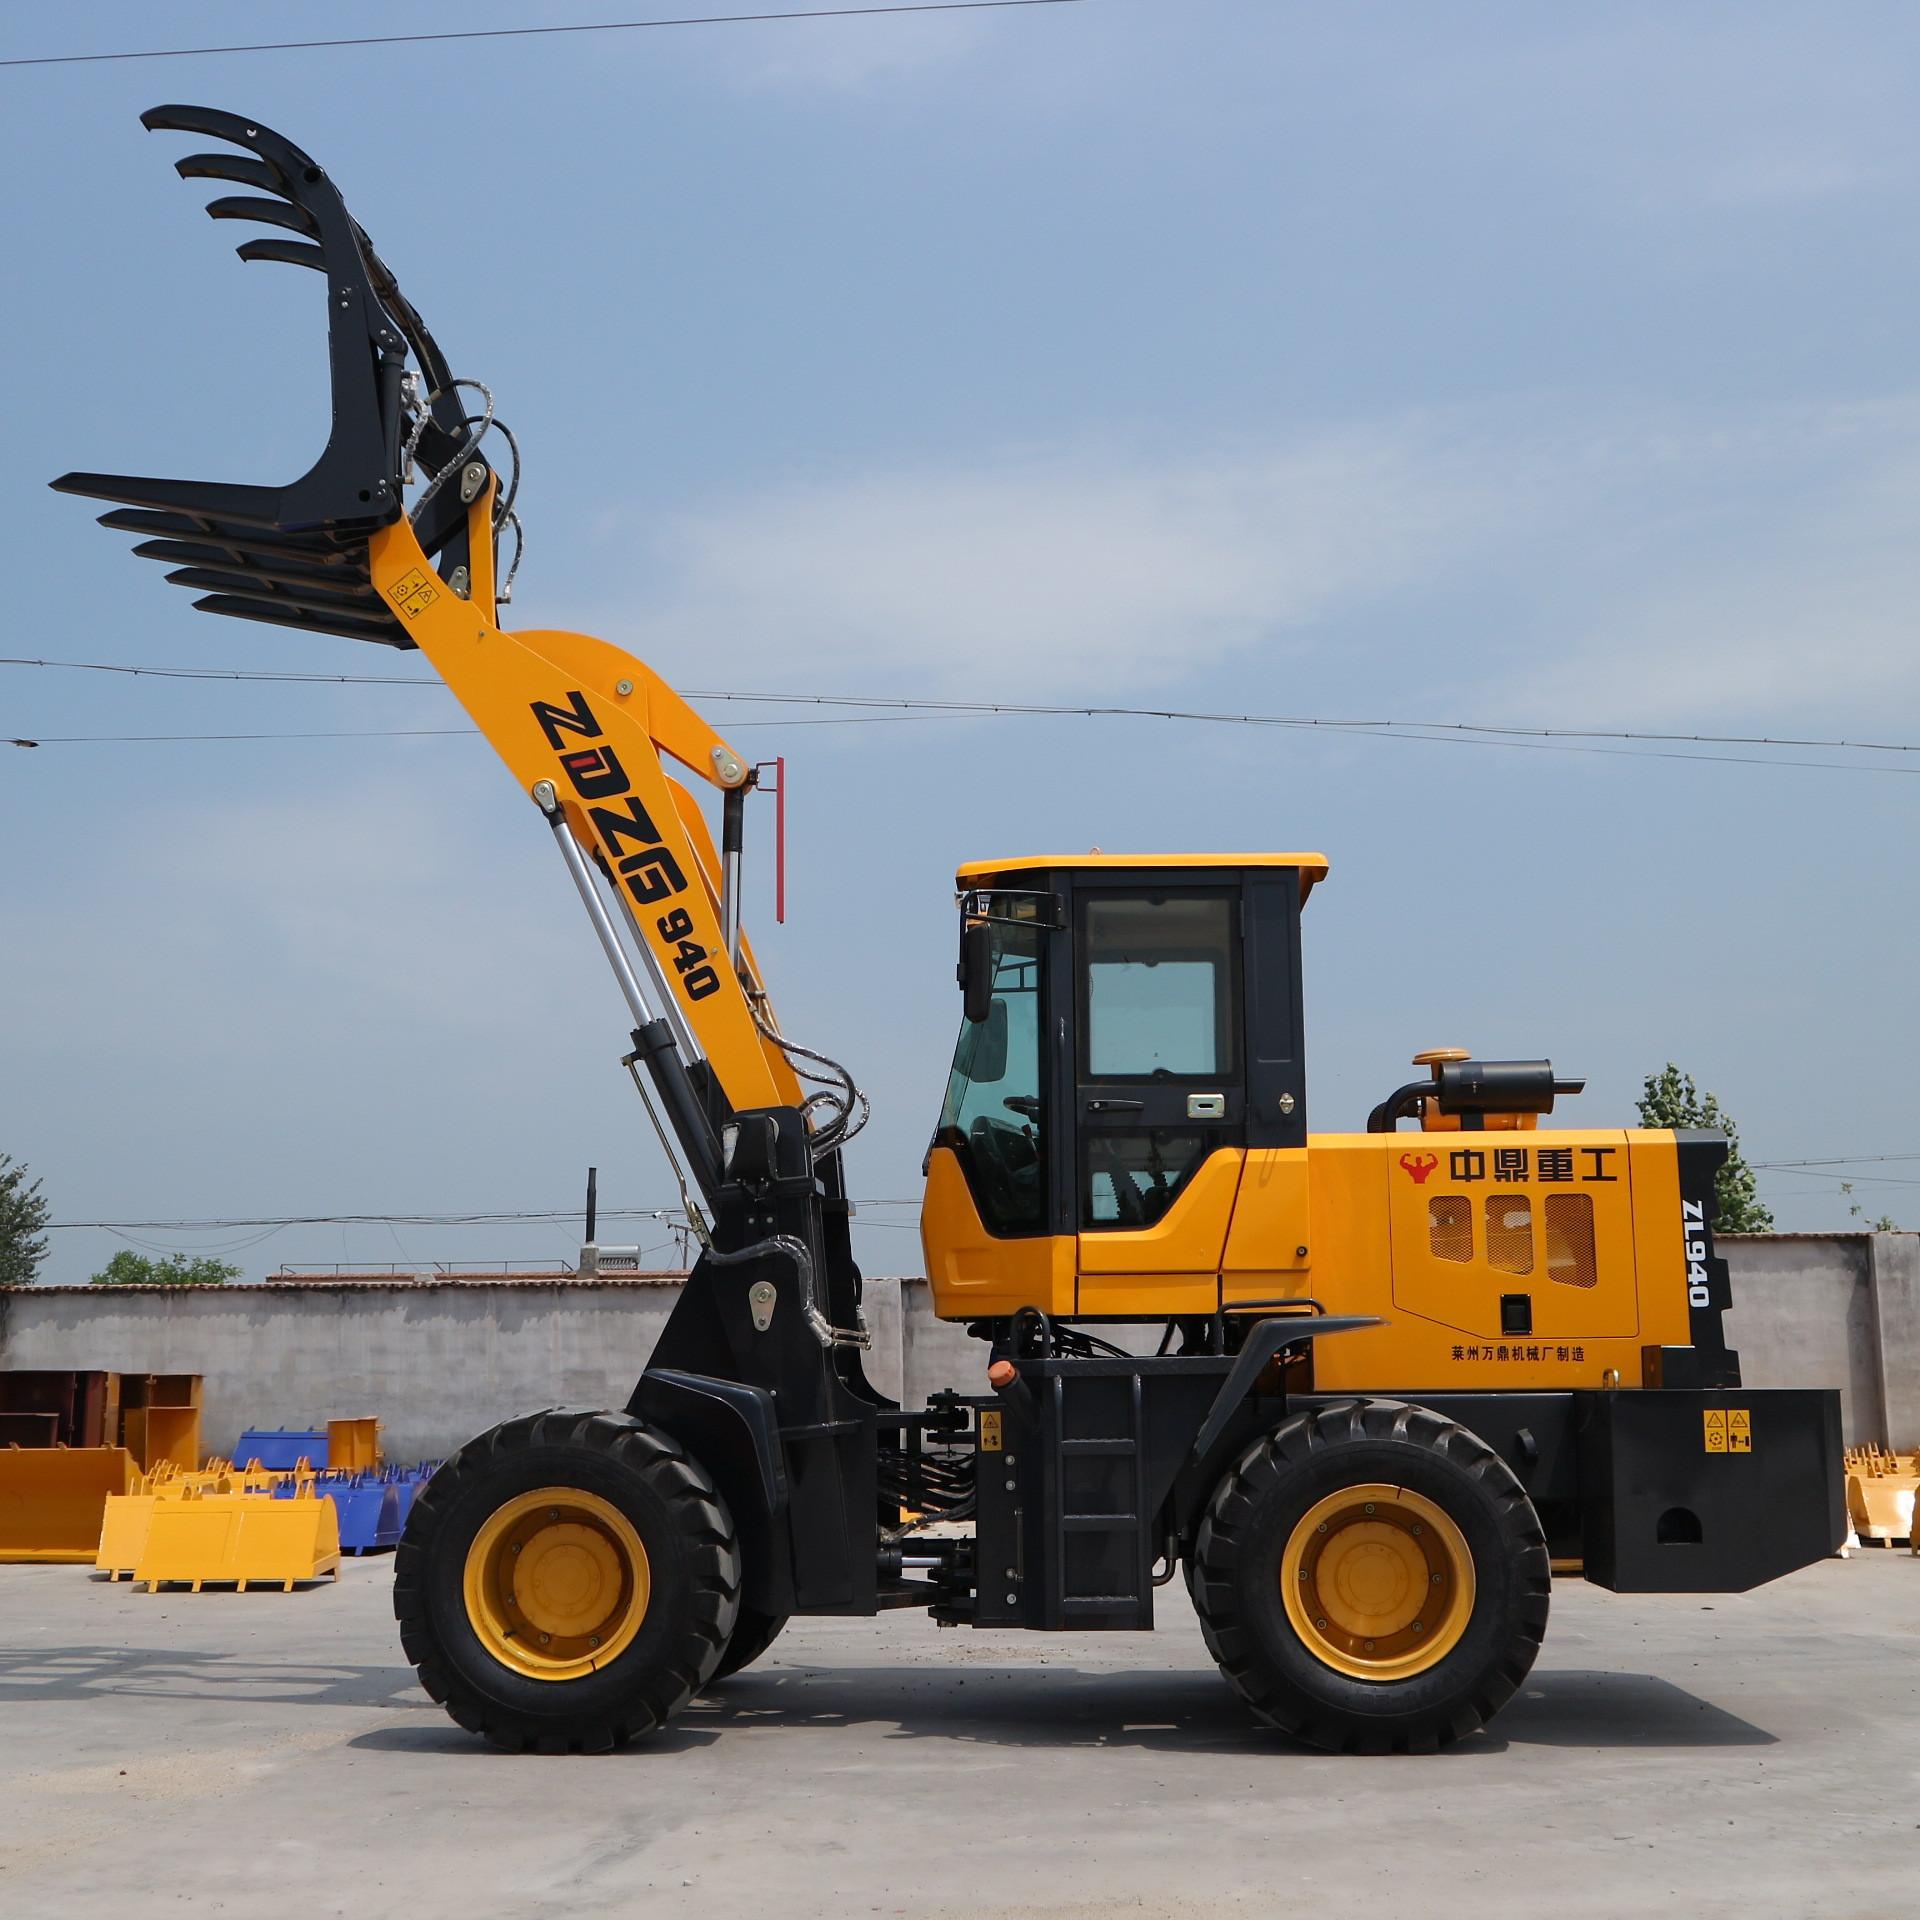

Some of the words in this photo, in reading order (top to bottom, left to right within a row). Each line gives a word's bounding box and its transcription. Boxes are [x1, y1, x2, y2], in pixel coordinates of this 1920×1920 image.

[656, 907, 720, 1002] 940
[1450, 1148, 1618, 1183] 中鼎重工
[1682, 1199, 1710, 1308] ZL940
[1451, 1345, 1585, 1362] 莱州万鼎机械厂制造
